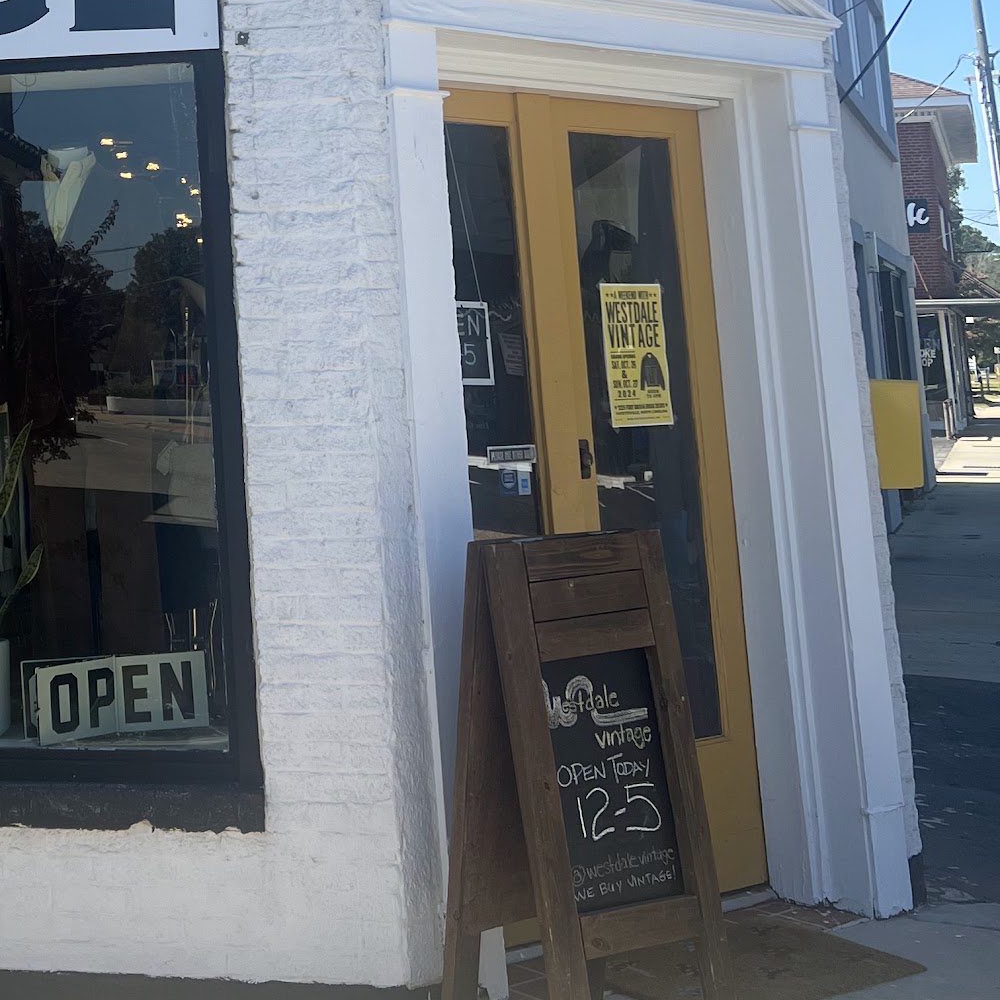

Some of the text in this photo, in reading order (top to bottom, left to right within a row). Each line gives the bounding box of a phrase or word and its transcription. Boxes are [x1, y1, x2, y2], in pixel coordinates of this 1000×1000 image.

[605, 301, 659, 324] WESTDALE
[608, 323, 661, 348] VINTAGE
[617, 390, 636, 398] 2024
[50, 661, 196, 734] OPEN
[594, 723, 652, 750] vintage
[556, 760, 607, 788] OPEN
[576, 781, 662, 841] 12-5
[574, 864, 677, 902] WE BUY VINTAGE!
